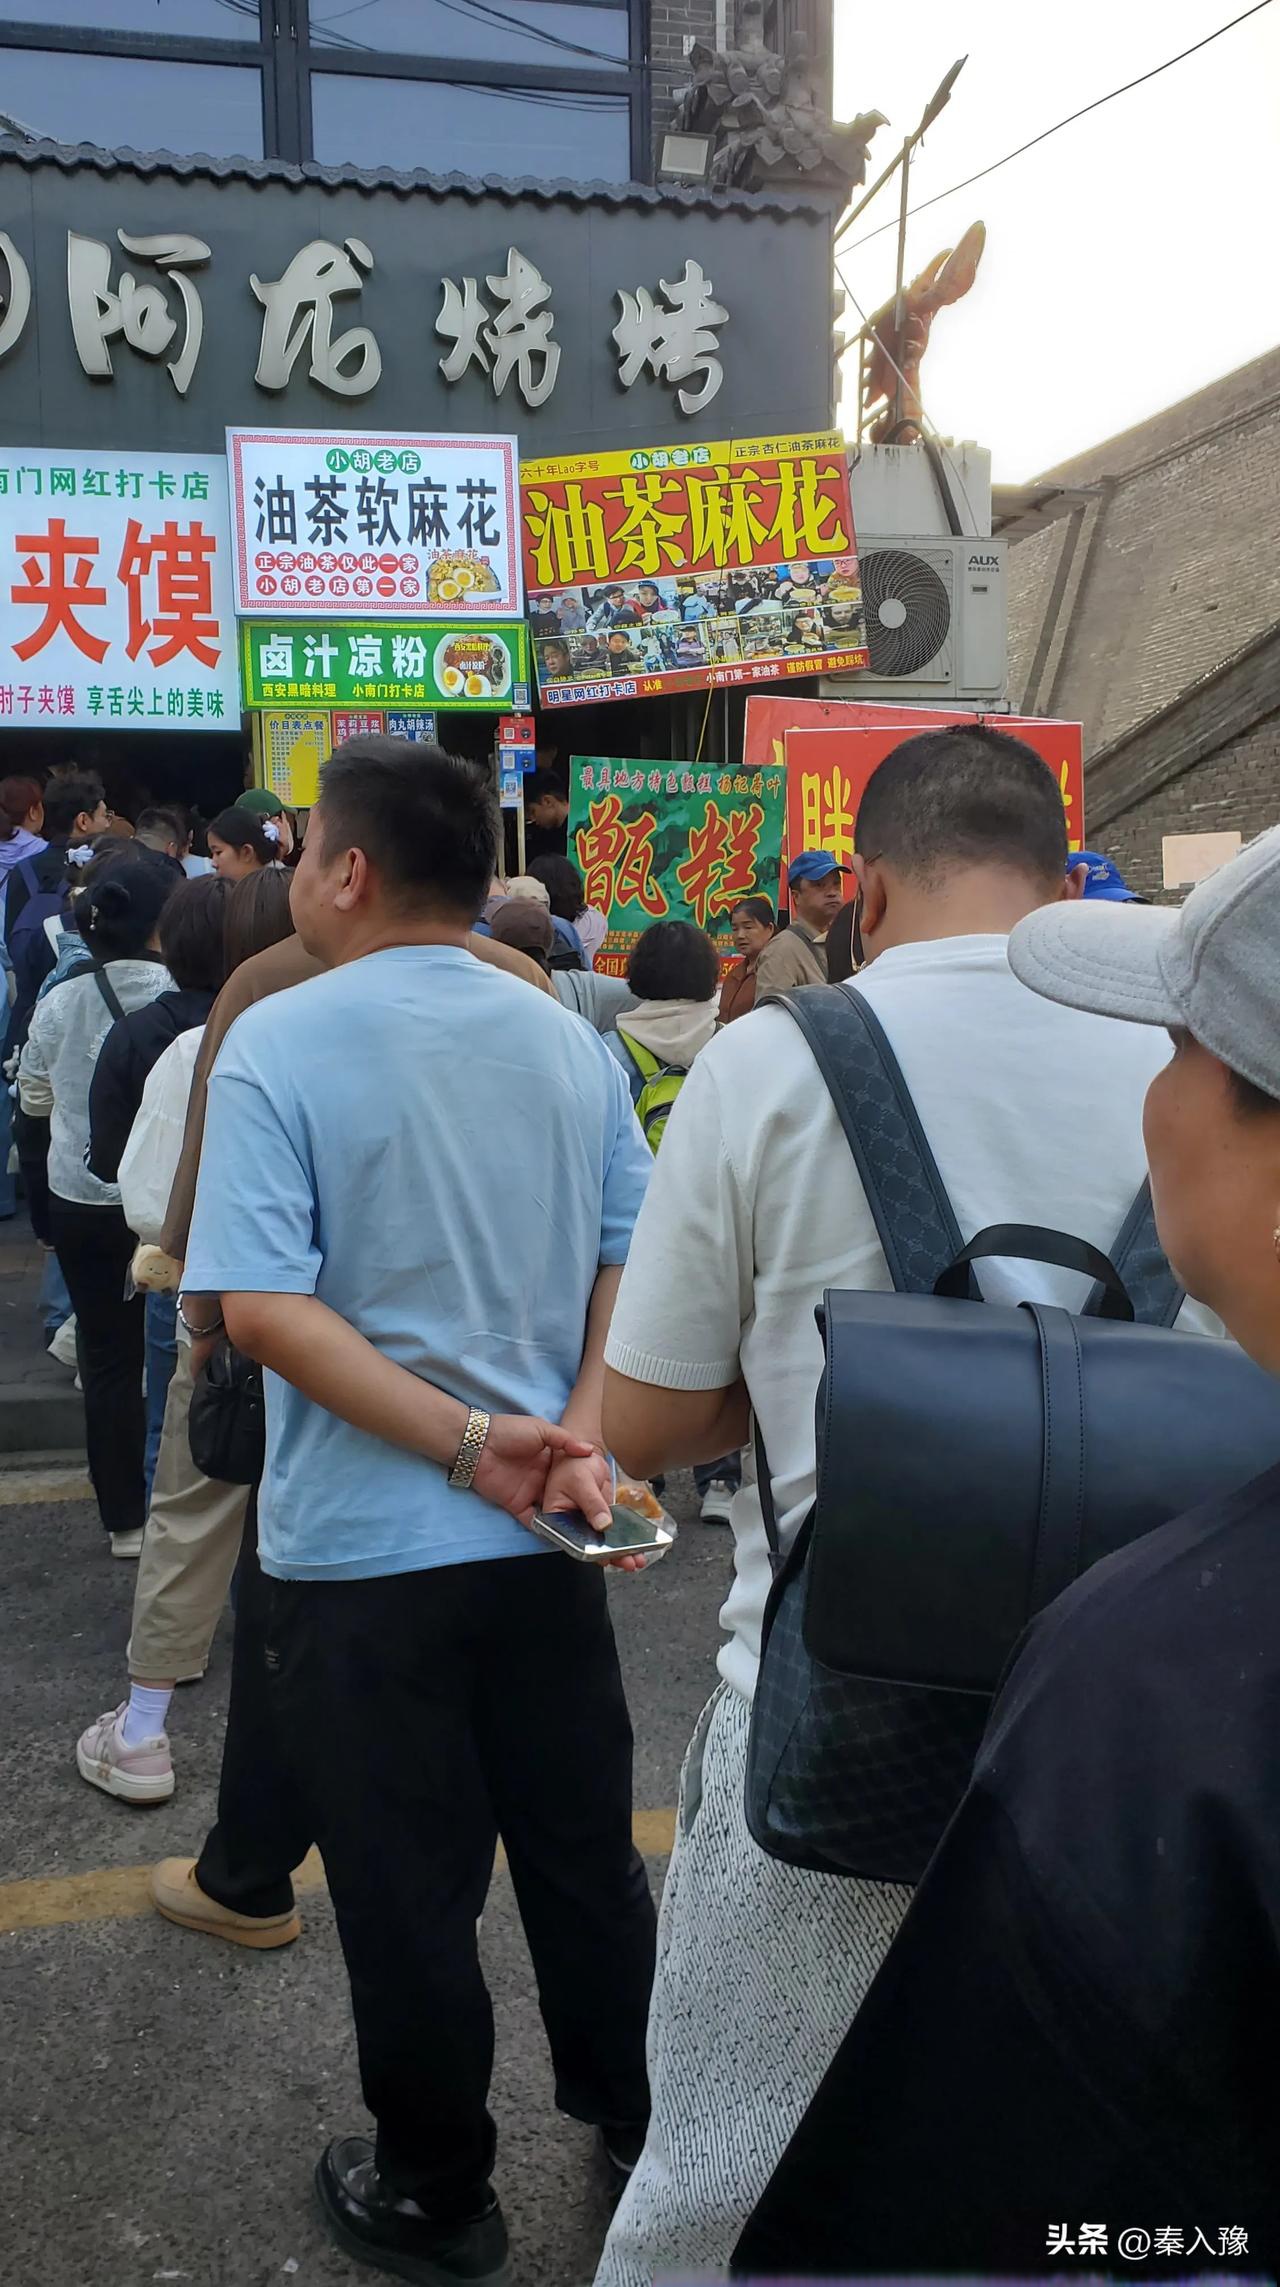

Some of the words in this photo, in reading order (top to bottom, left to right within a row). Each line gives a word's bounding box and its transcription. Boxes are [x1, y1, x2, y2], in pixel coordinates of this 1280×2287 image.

[327, 449, 420, 473] 小胡老店
[520, 460, 600, 479] 六十年Lao字号
[630, 446, 711, 470] 小胡老店
[253, 474, 501, 549] 油茶软麻花
[524, 459, 849, 586] 油茶麻花
[256, 553, 418, 573] 正宗油茶仅此一家
[968, 555, 999, 566] AUX
[11, 516, 222, 671] 夹馍
[256, 576, 420, 597] 小胡老店第一家
[259, 633, 427, 679] 卤汁凉粉
[262, 683, 337, 698] 西安黑暗料理
[352, 683, 425, 699] 小南门打卡店
[547, 681, 637, 703] 明星网红打卡店
[643, 679, 663, 692] 认准
[706, 664, 780, 684] 小南门第一家油茶
[87, 685, 224, 718] 享舌尖上的美味
[389, 719, 433, 731] 肉丸胡辣汤
[576, 794, 773, 928] 甑糕
